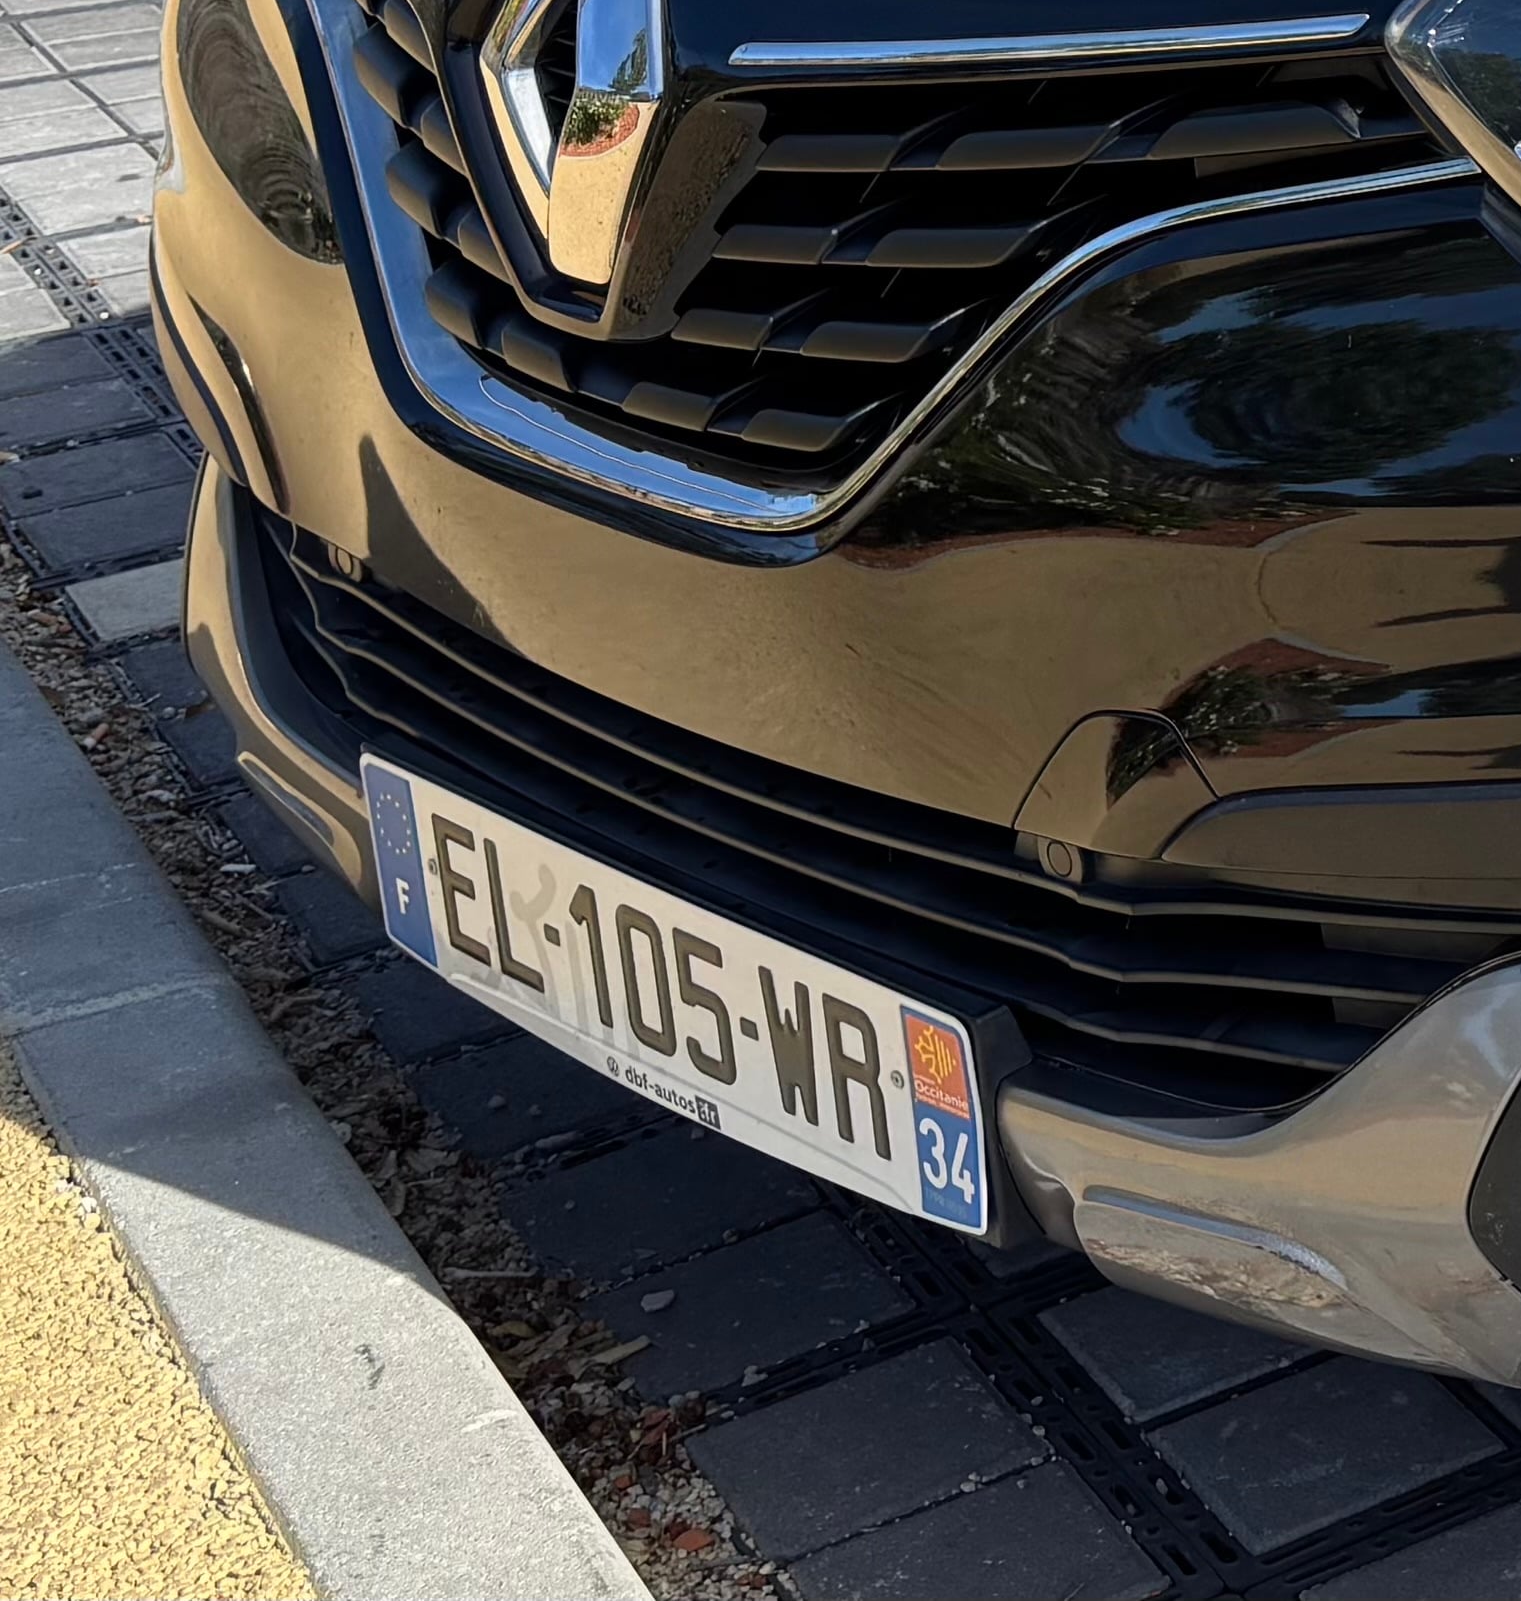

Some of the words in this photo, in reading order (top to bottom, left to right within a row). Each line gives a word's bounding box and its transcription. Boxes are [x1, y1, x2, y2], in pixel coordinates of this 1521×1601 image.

[394, 878, 411, 915] F
[431, 812, 892, 1161] EL-105-WR
[919, 1117, 975, 1205] 34
